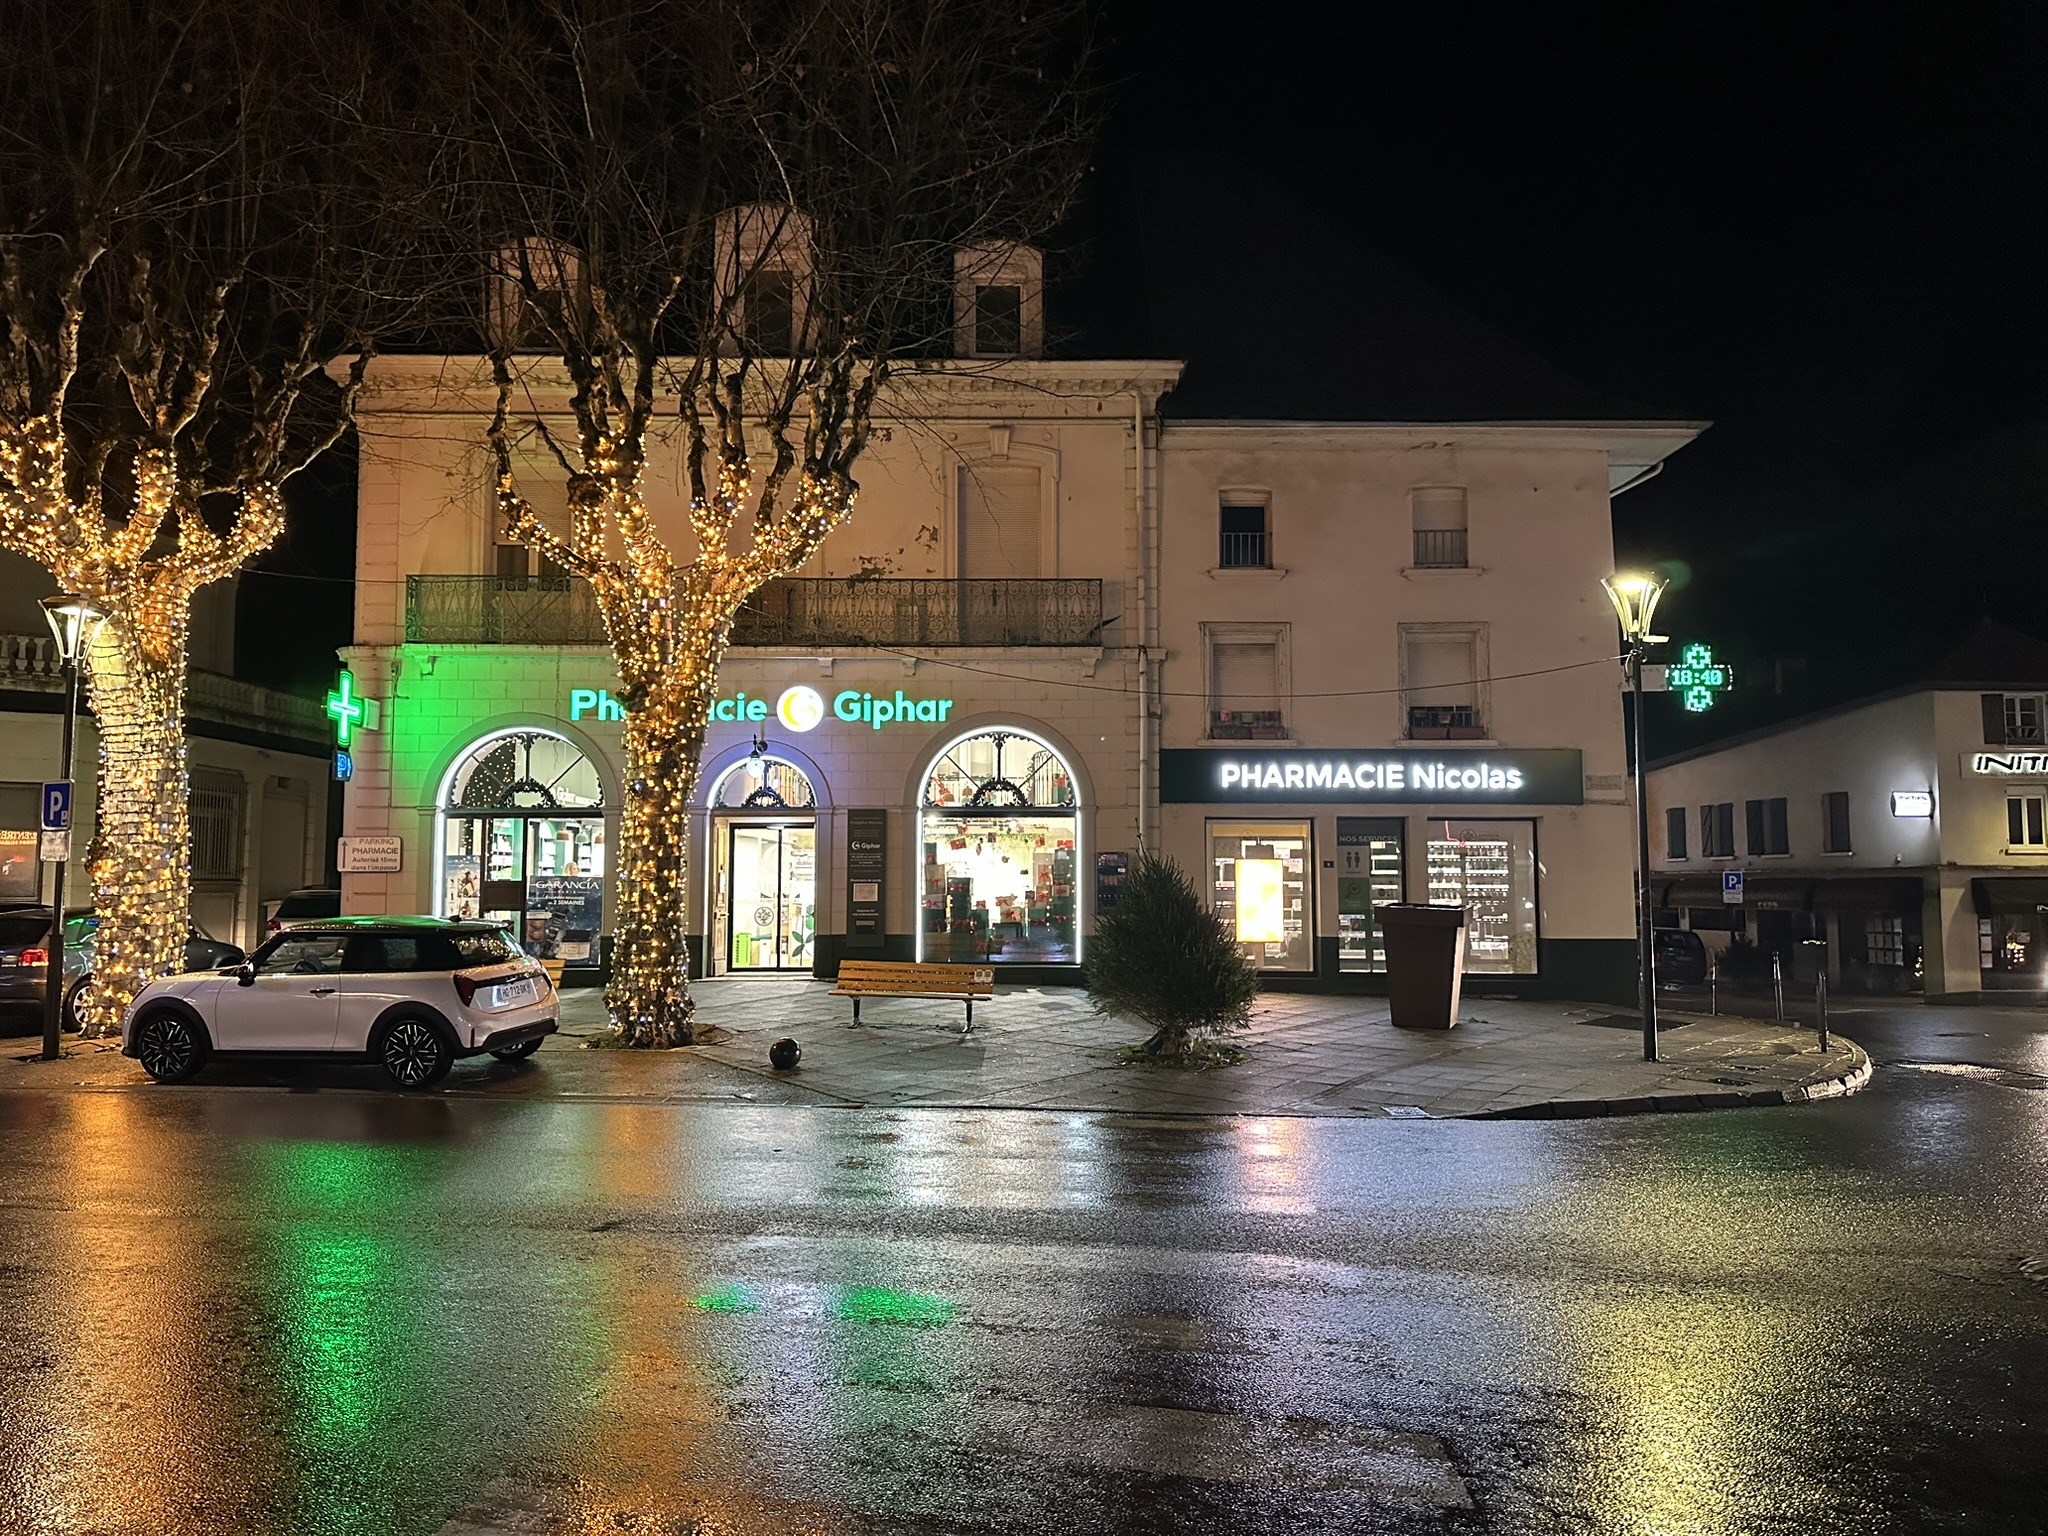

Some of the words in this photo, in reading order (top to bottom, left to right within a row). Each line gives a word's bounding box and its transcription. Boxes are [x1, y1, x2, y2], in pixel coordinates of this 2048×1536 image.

[1671, 669, 1723, 686] 18:40
[571, 689, 768, 722] Phcie
[833, 690, 953, 730] Giphar
[1220, 763, 1405, 790] PHARMACIE
[1412, 763, 1523, 791] Nicolas
[49, 790, 63, 821] P
[1339, 835, 1357, 843] NOS
[1728, 875, 1738, 887] P
